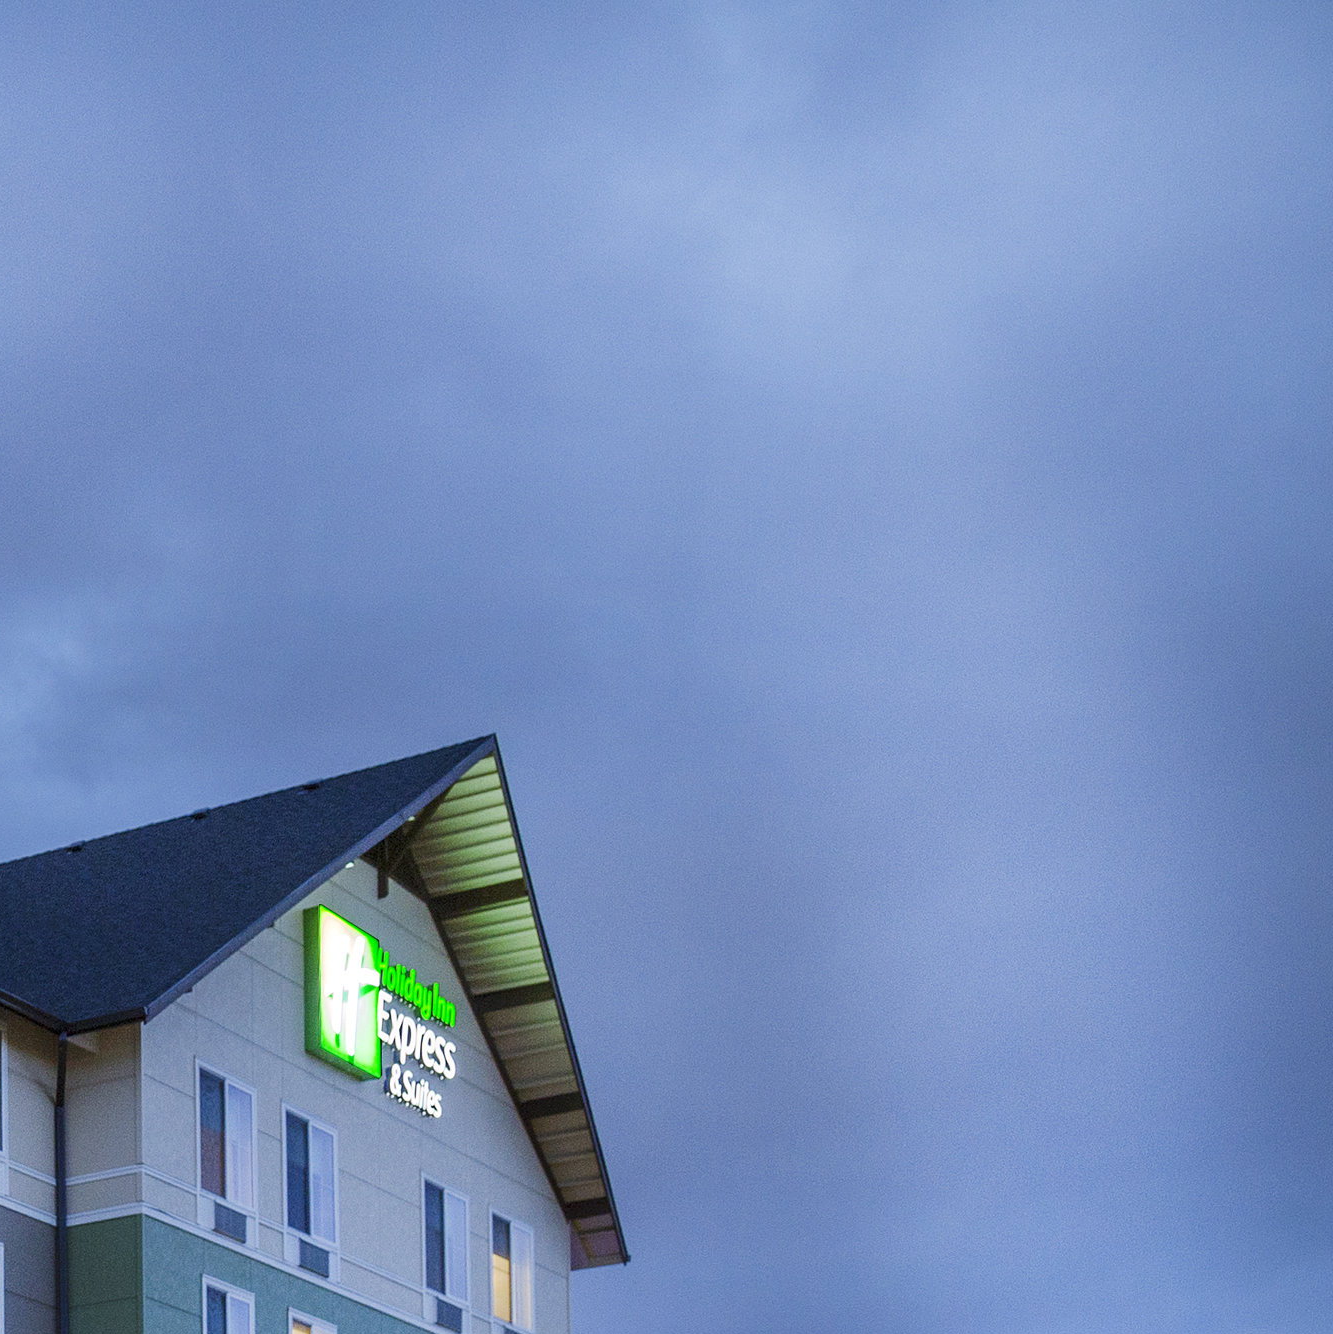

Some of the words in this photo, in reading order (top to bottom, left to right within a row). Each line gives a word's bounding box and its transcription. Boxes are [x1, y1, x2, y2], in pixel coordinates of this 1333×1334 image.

[378, 947, 433, 1020] Holiday
[433, 982, 456, 1028] Inn
[377, 990, 456, 1079] Express
[390, 1063, 402, 1097] &
[402, 1070, 442, 1118] Suites
